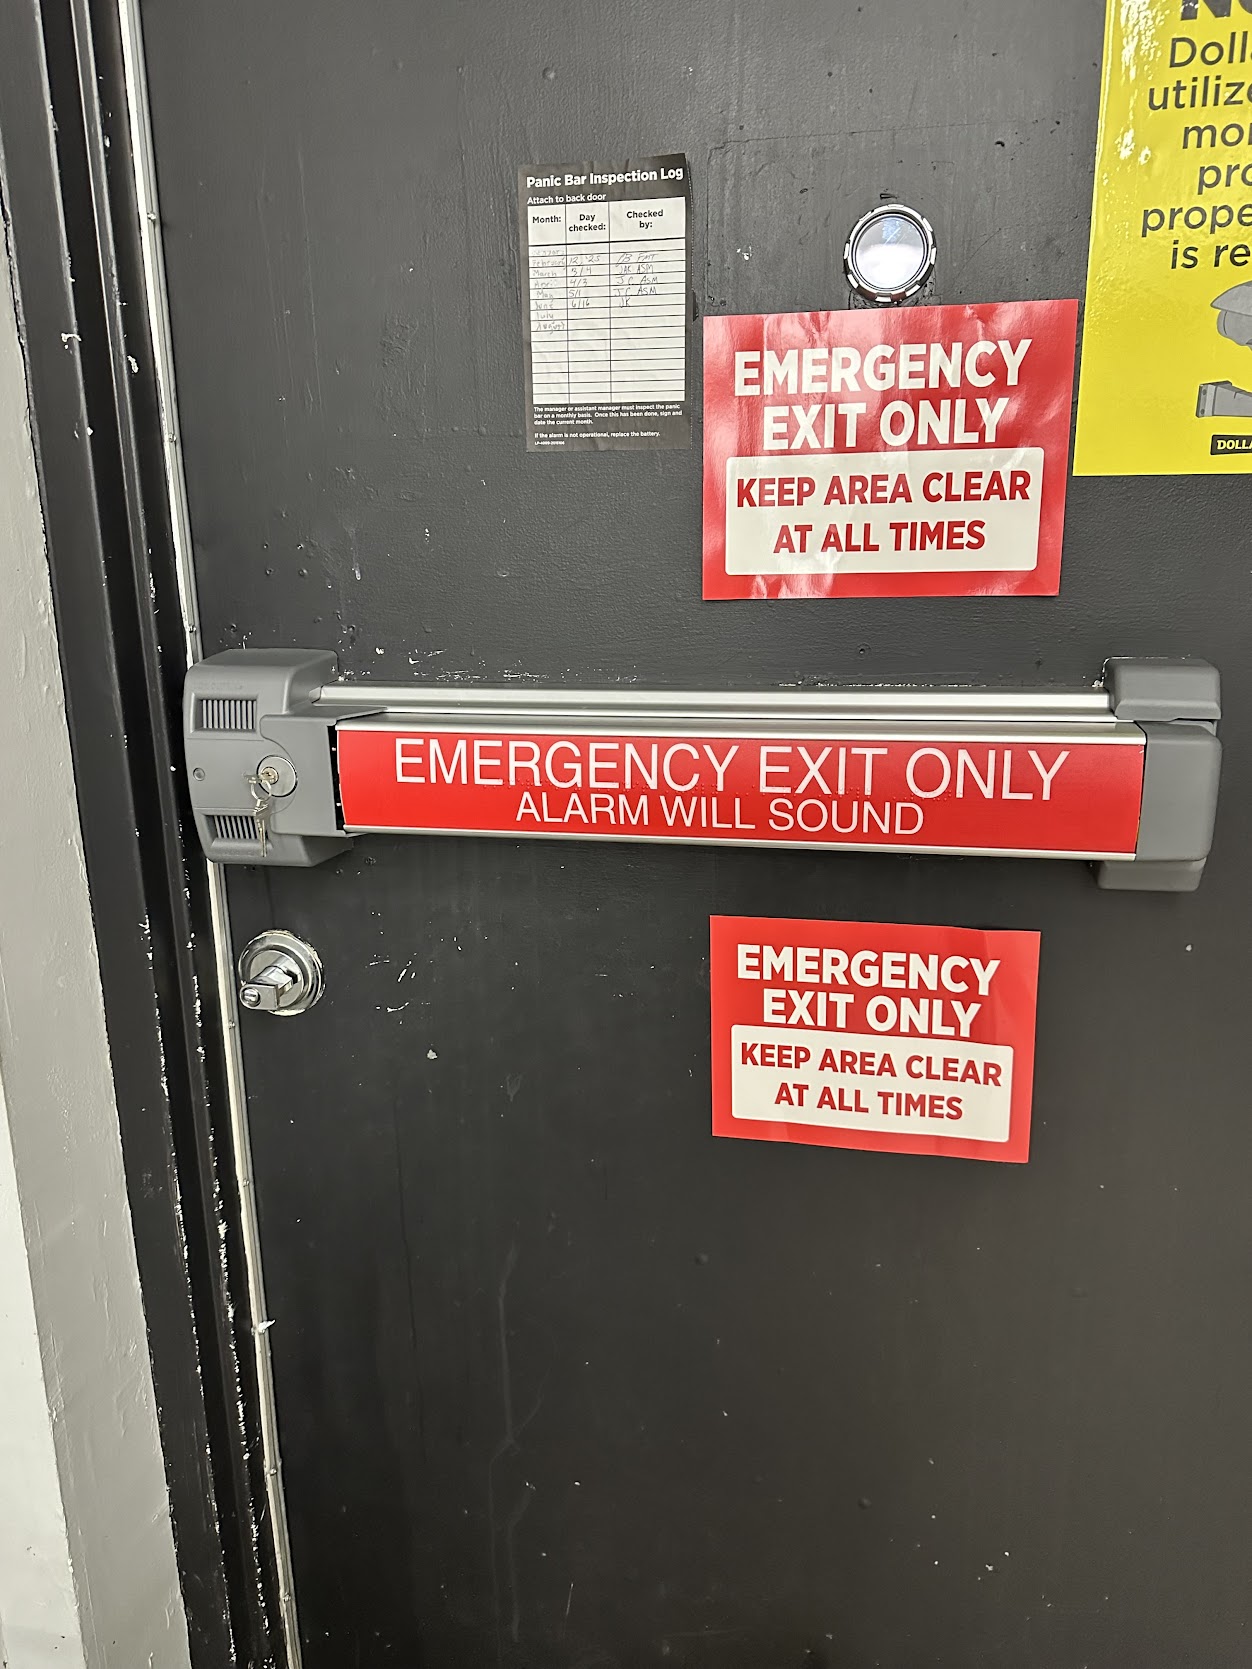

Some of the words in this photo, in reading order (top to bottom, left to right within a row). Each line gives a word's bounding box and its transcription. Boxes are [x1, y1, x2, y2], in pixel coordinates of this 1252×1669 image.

[1169, 31, 1252, 68] Doll
[1148, 75, 1252, 110] utiliz
[1182, 122, 1252, 149] mo
[526, 175, 562, 188] Panic
[564, 174, 587, 186] Bar
[590, 170, 658, 186] Inspection
[660, 167, 684, 180] Log
[527, 196, 554, 204] Attach
[566, 194, 586, 202] back
[587, 193, 606, 202] door
[626, 209, 664, 219] Checked
[532, 215, 562, 223] Month:
[568, 223, 606, 232] checked:
[579, 213, 596, 222] Day
[639, 221, 653, 229] by:
[1141, 204, 1252, 237] prope
[1171, 240, 1199, 269] is
[1214, 244, 1252, 268] re
[734, 338, 1033, 397] EMERGENCY
[762, 402, 867, 450] EXIT
[879, 397, 1010, 447] ONLY
[1216, 439, 1252, 450] DOLL
[737, 477, 816, 508] KEEP
[823, 473, 913, 506] AREA
[922, 470, 1031, 502] CLEAR
[773, 524, 813, 554] AT
[820, 523, 880, 552] ALL
[889, 519, 986, 551] TIMES
[395, 738, 740, 792] EMERGENCY
[759, 745, 889, 796] EXIT
[905, 747, 1070, 801] ONLY
[516, 791, 649, 826] ALARM
[659, 796, 756, 829] WILL
[768, 797, 924, 835] SOUND
[737, 943, 1001, 996] EMERGENCY
[763, 988, 855, 1029] EXIT
[865, 995, 982, 1038] ONLY
[741, 1042, 811, 1069] KEEP
[818, 1048, 898, 1078] AREA
[906, 1055, 1003, 1087] CLEAR
[774, 1082, 809, 1107] AT
[816, 1086, 869, 1114] ALL
[877, 1091, 963, 1121] TIMES
